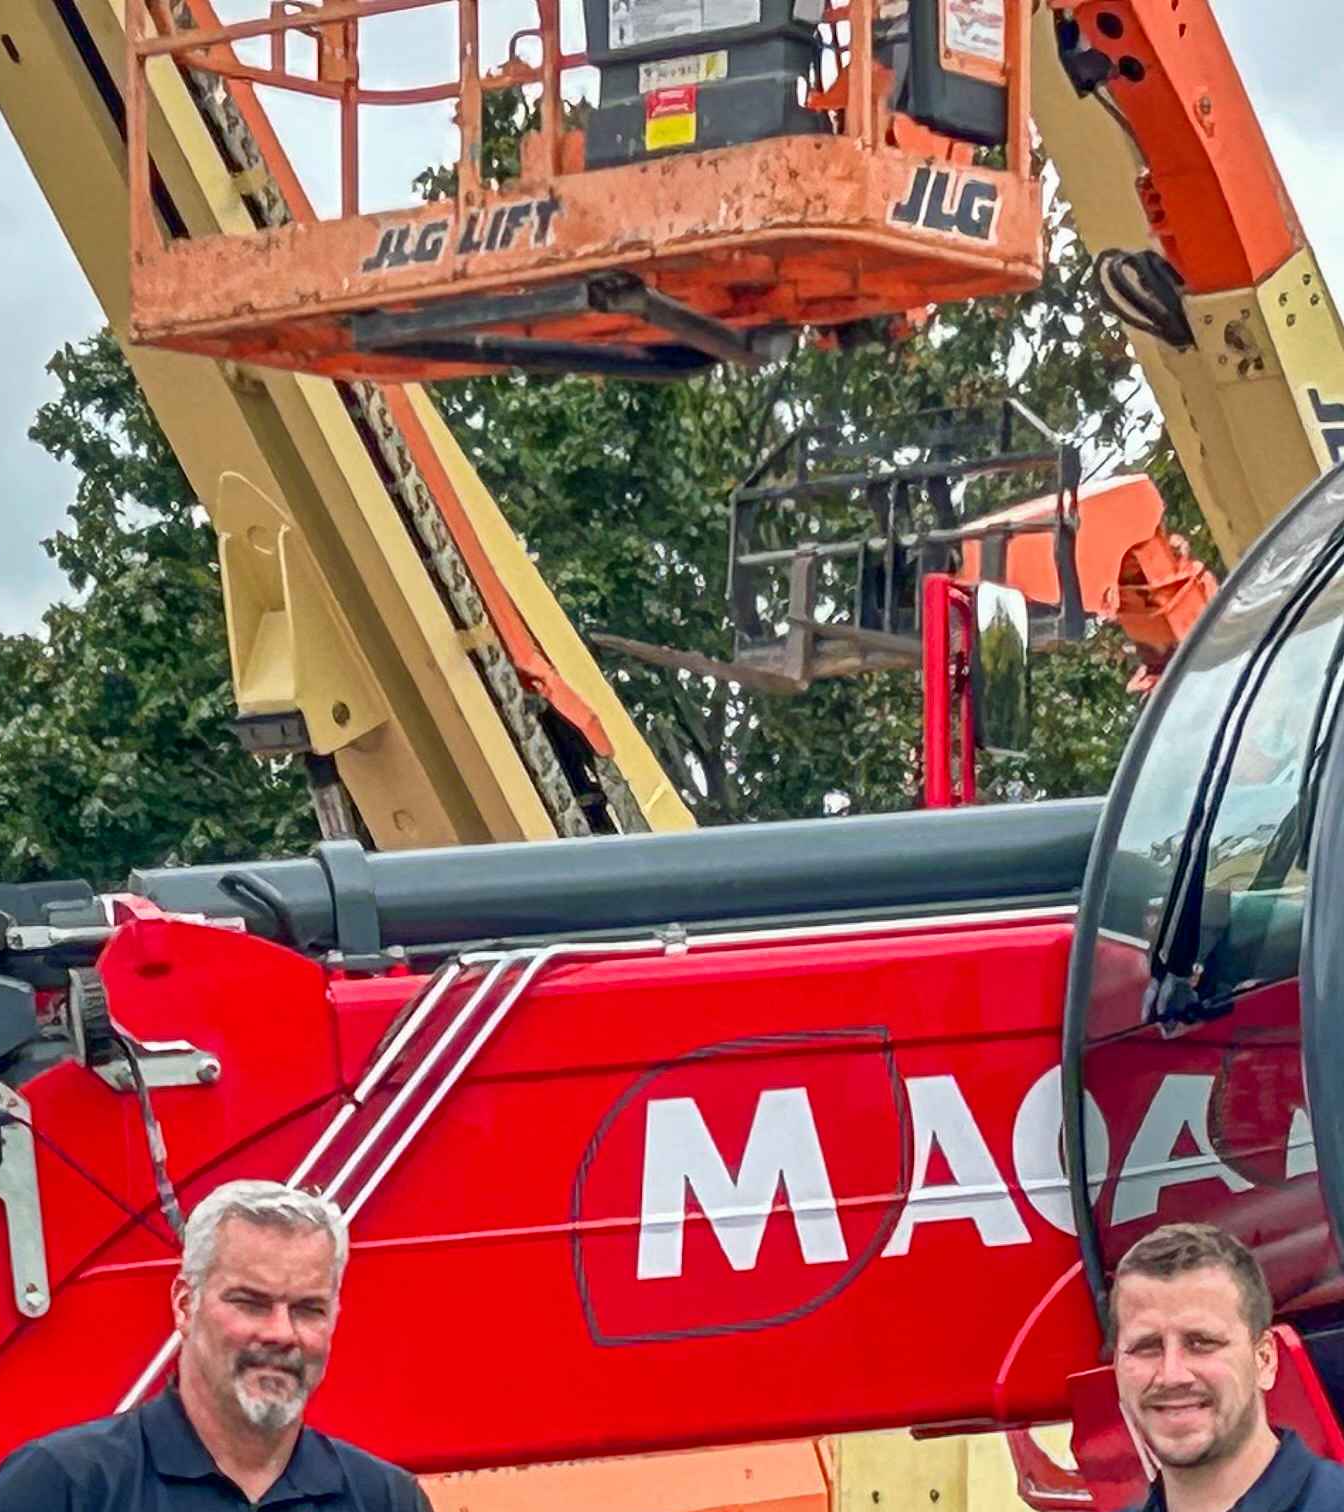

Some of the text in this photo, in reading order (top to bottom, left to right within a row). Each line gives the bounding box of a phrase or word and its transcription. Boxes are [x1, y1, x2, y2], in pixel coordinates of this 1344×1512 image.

[362, 195, 563, 272] JLG LIFT
[892, 167, 998, 240] JLG
